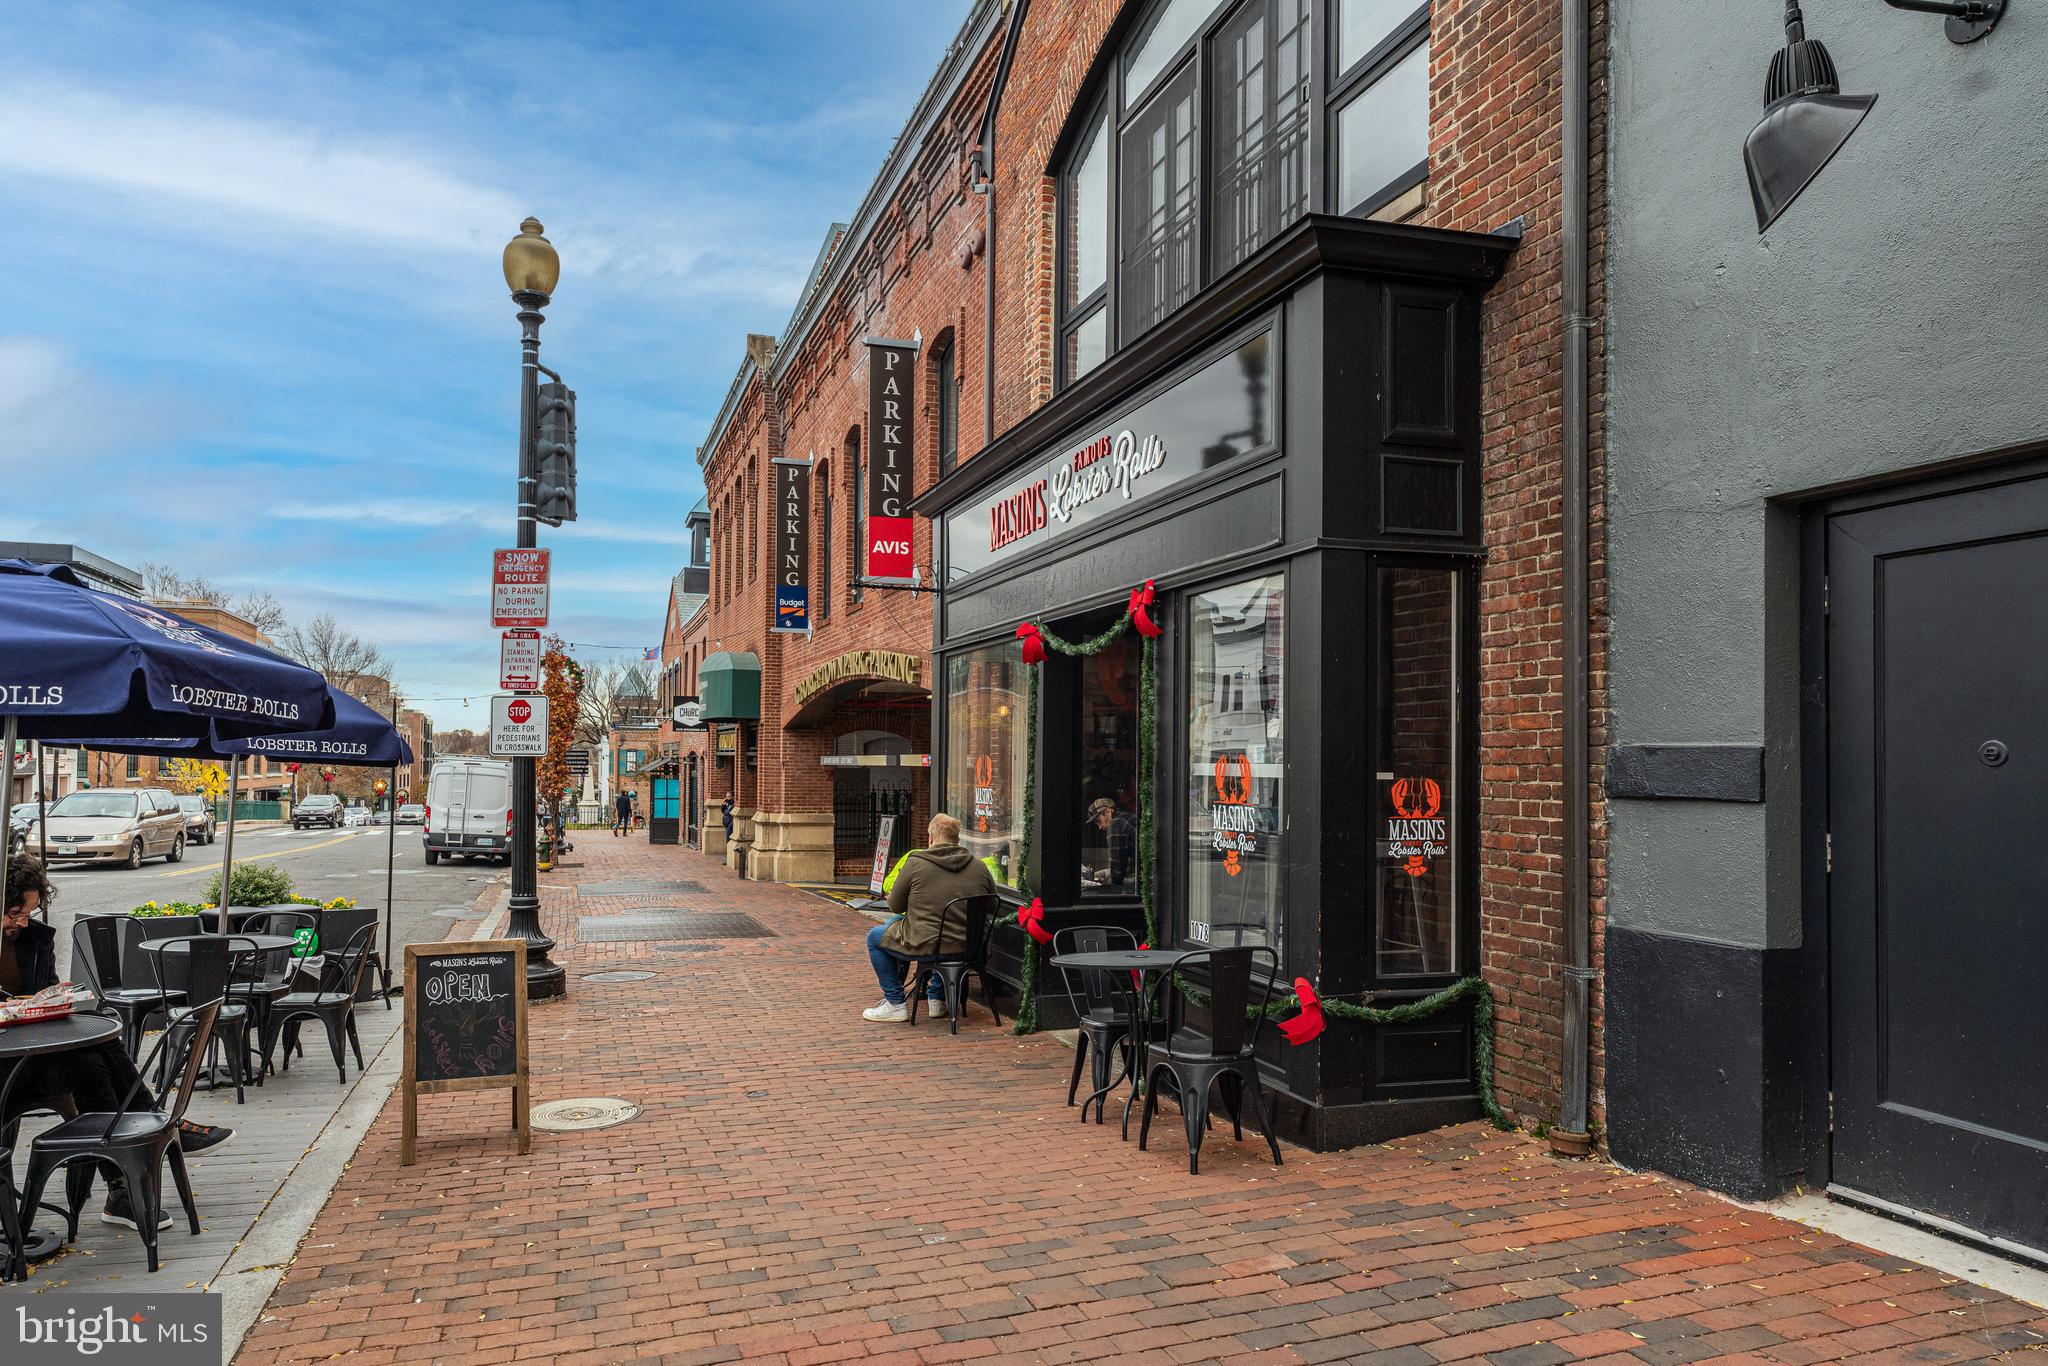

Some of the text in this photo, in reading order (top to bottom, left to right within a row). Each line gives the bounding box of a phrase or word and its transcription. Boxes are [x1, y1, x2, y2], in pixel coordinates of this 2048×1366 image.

[882, 351, 902, 517] PARKING
[1073, 435, 1112, 473] FAMOUS
[989, 429, 1167, 552] MASON'S Lobster Rolls
[786, 467, 800, 587] PARKING
[872, 540, 910, 555] AVIS
[505, 552, 540, 563] SNOW
[504, 573, 539, 582] ROUTE
[498, 587, 544, 595] NO PARKING
[505, 597, 536, 605] DURING
[779, 599, 805, 608] Budget
[496, 608, 544, 616] EMERGENCY
[170, 684, 299, 720] LOBSTER ROLLS
[509, 706, 530, 717] STOP
[247, 737, 367, 755] LOBSTER ROLLS
[1213, 804, 1255, 833] MASON'S
[1388, 819, 1446, 841] MASON'S
[1212, 831, 1237, 852] Lobster
[1388, 841, 1448, 859] Lobster Rolls
[1190, 920, 1210, 943] 1078
[425, 970, 491, 1000] OPEN
